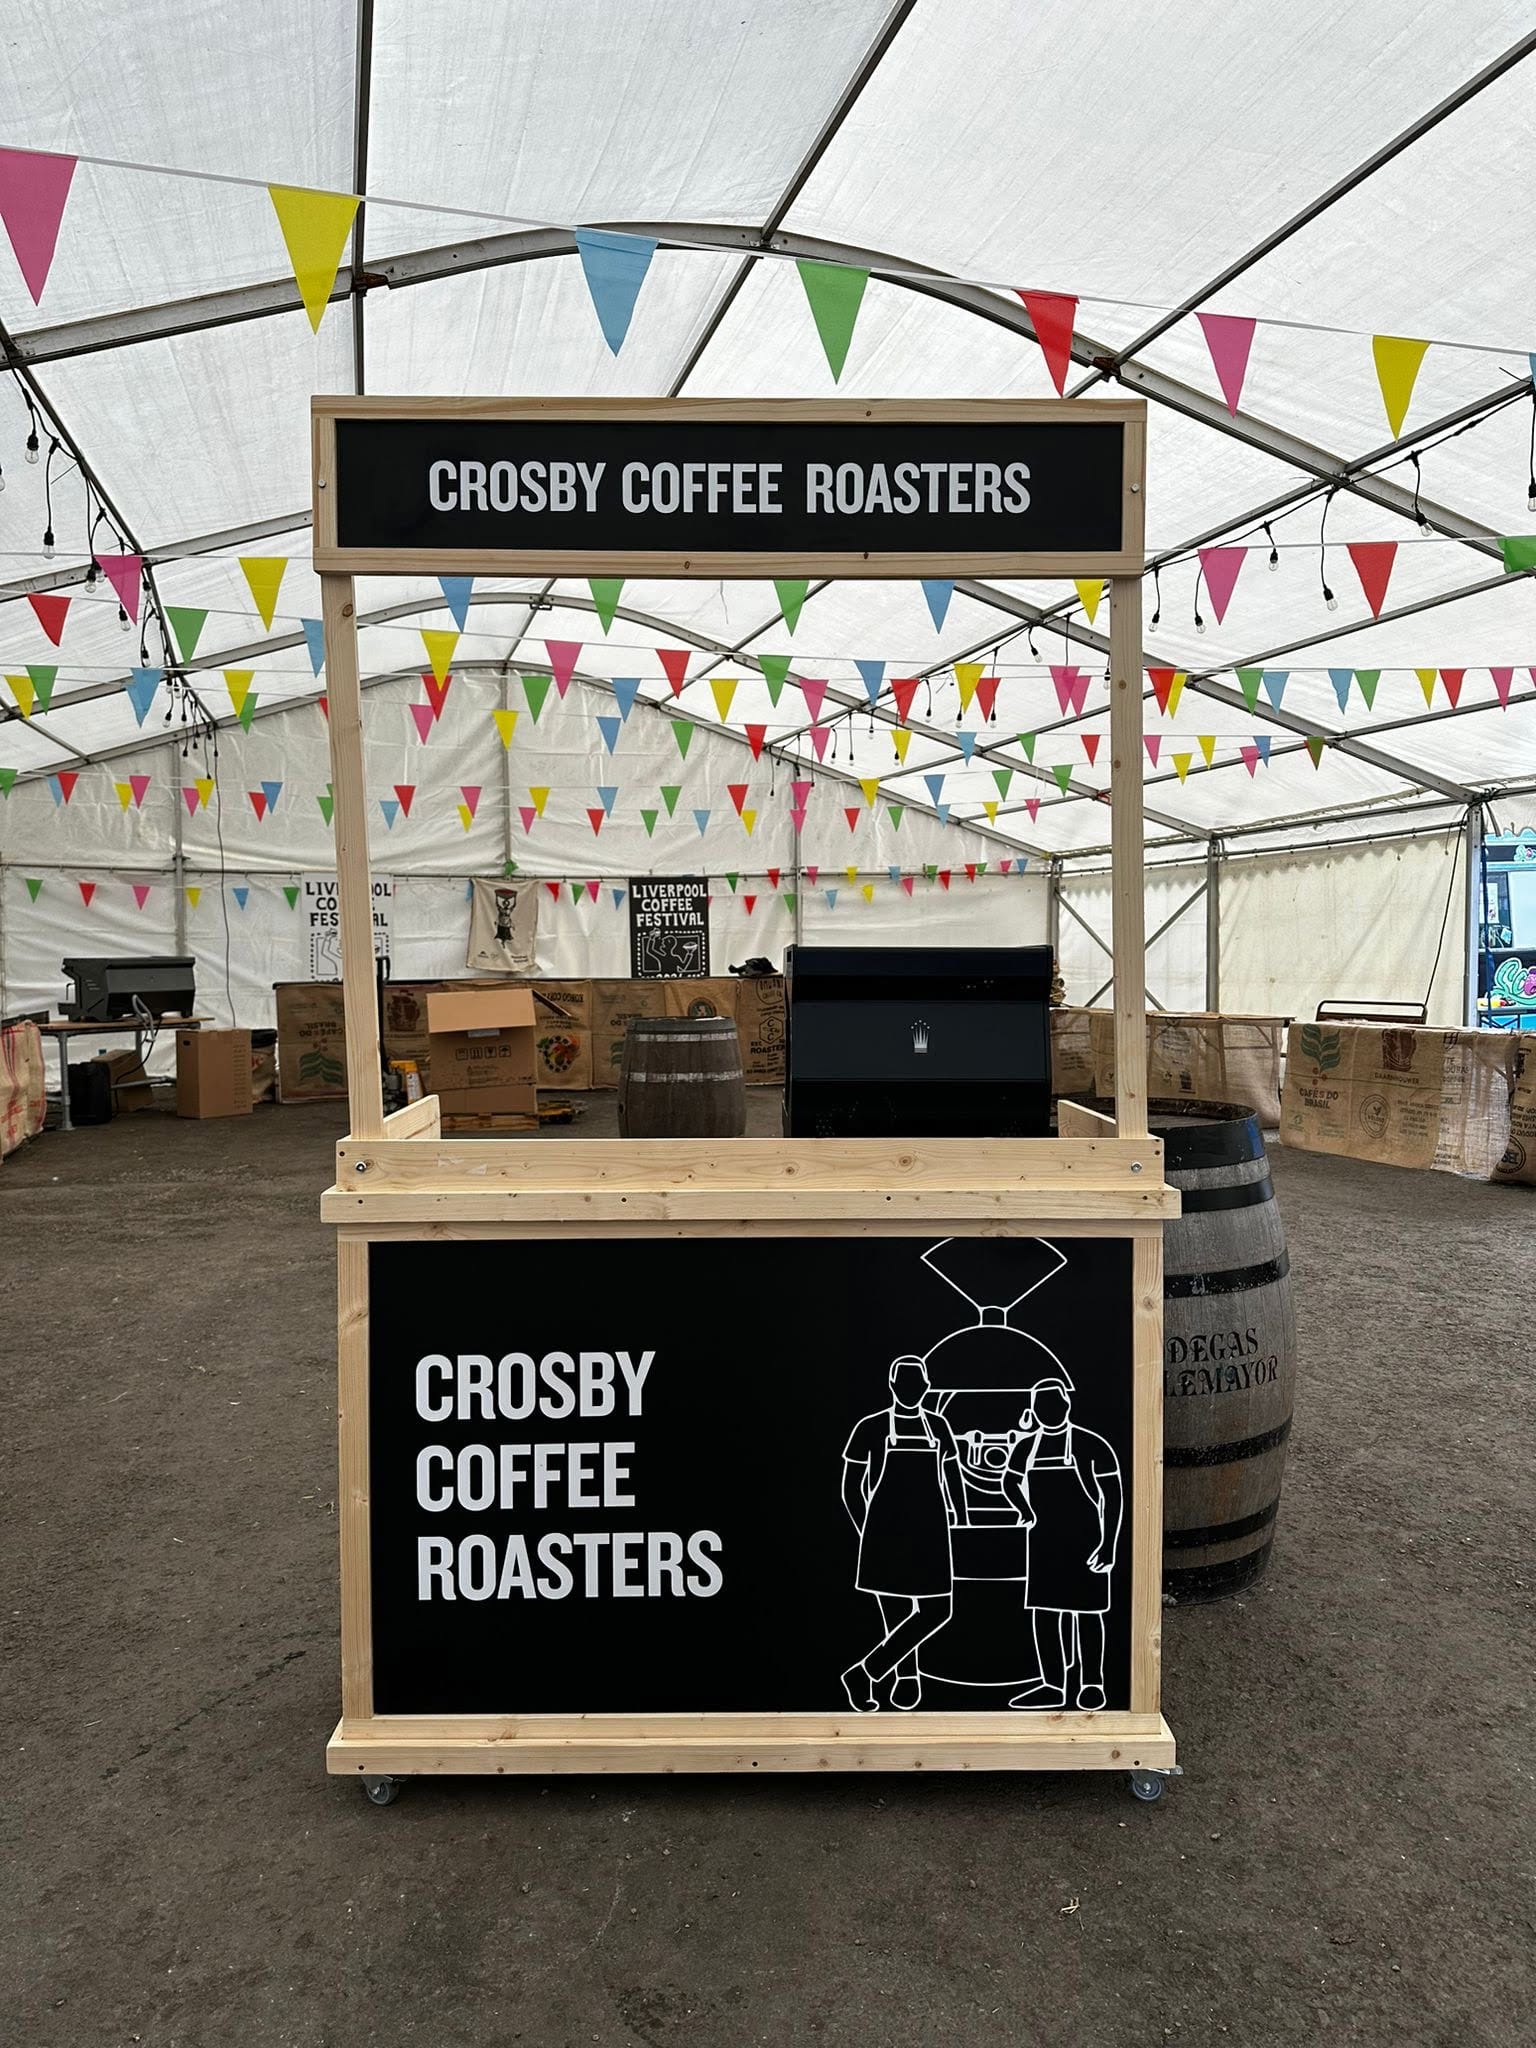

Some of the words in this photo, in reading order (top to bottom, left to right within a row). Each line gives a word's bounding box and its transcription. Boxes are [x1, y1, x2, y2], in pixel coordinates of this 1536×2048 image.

[430, 461, 606, 512] CROSBY
[623, 462, 782, 514] COFFEE
[807, 463, 1031, 515] ROASTERS
[632, 884, 707, 898] LIVERPOOL
[641, 898, 693, 912] COFFEE
[636, 912, 704, 927] FESTIVAL
[1304, 1099, 1331, 1110] BRASIL
[1326, 1090, 1339, 1100] DO
[1167, 1327, 1259, 1363] DEGAS
[416, 1351, 656, 1422] CROSBY
[416, 1442, 636, 1512] COFFEE
[418, 1530, 723, 1601] ROASTERS
